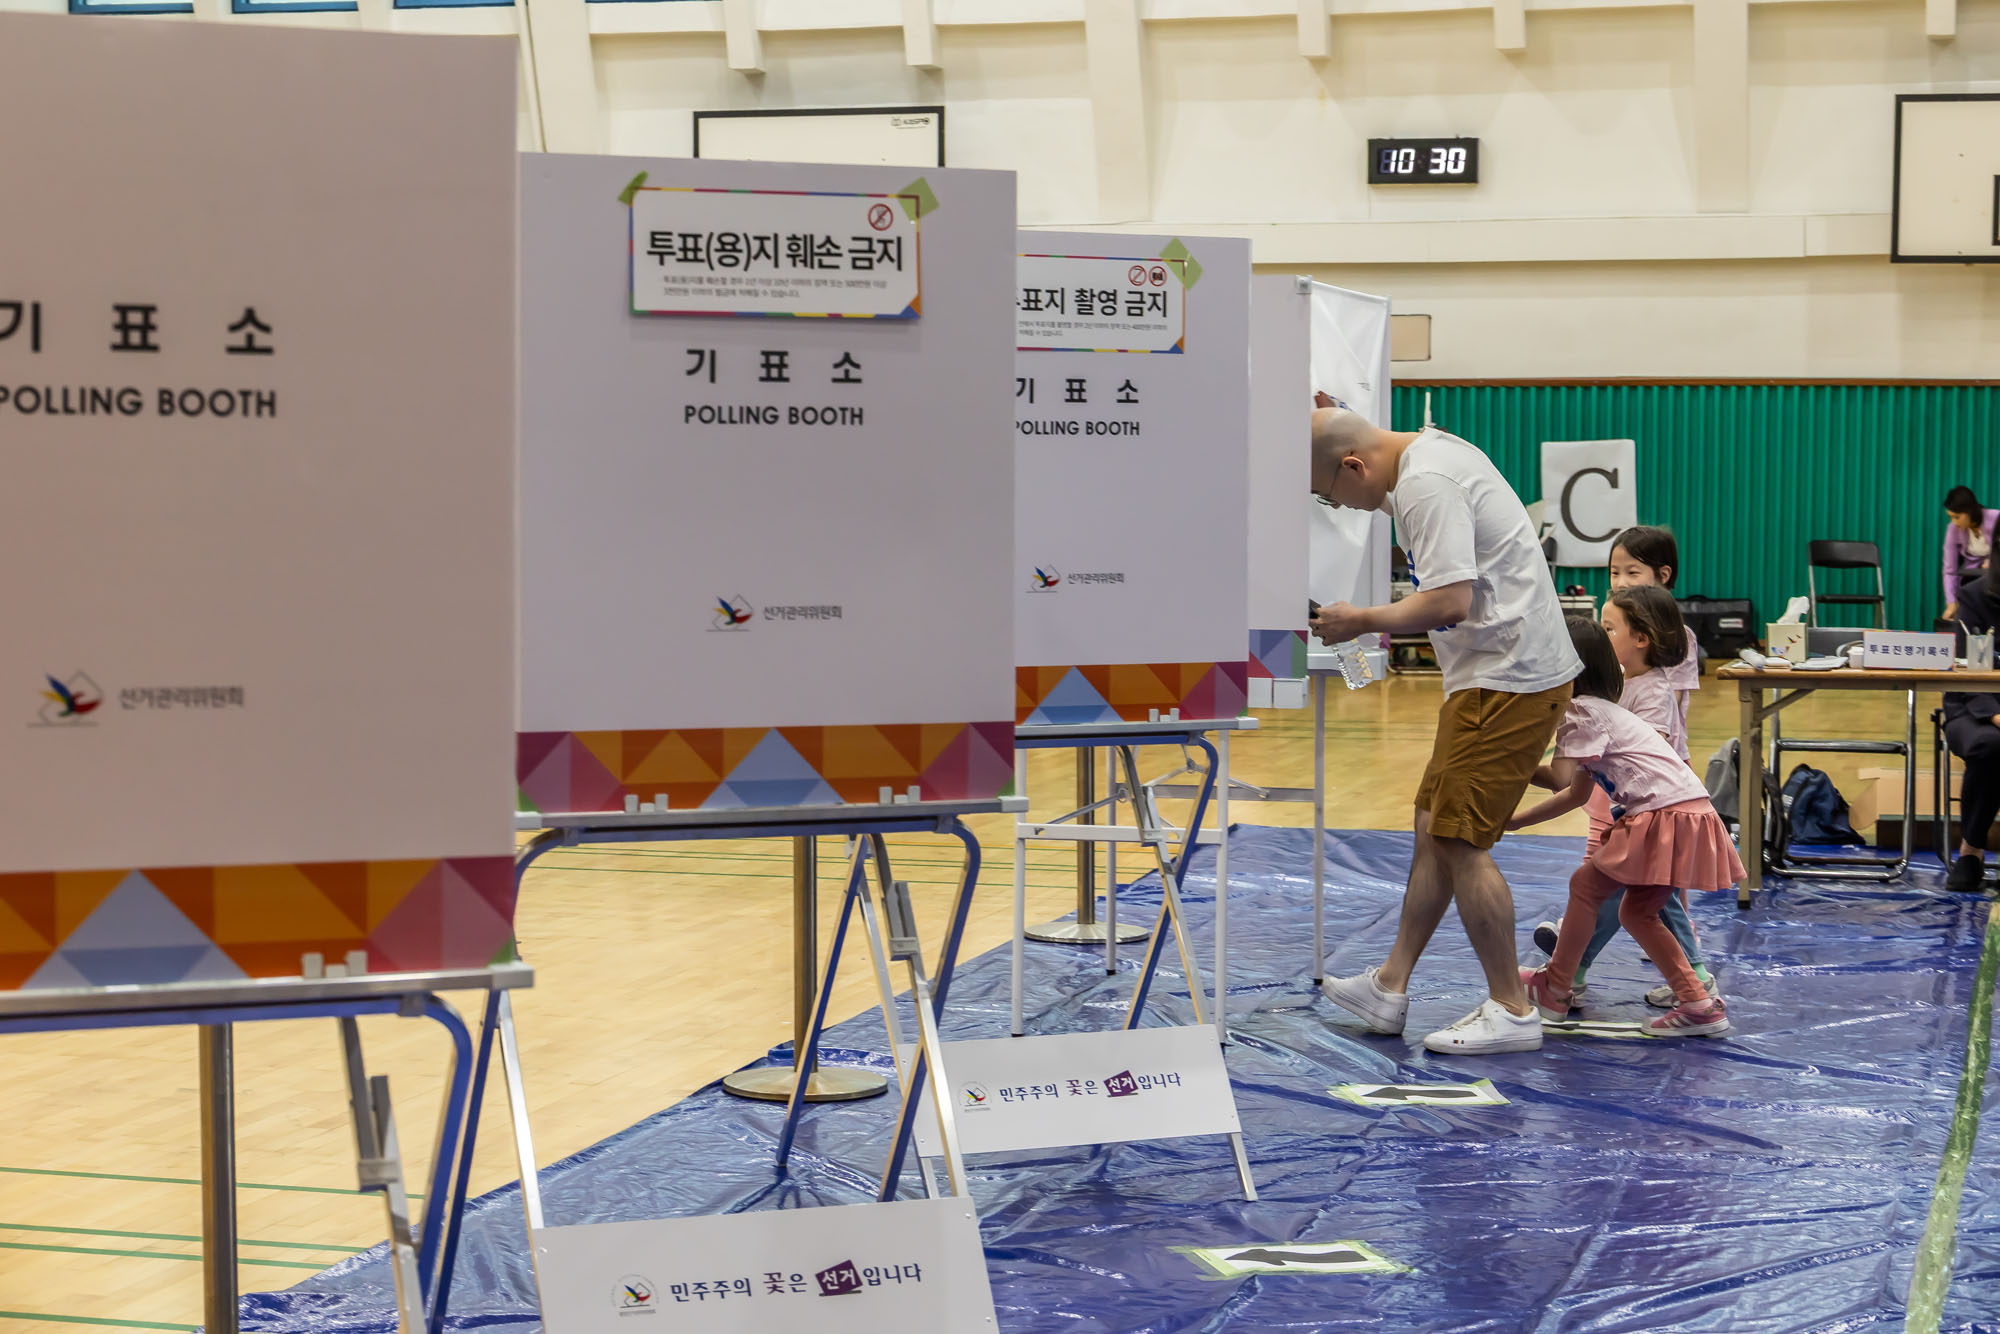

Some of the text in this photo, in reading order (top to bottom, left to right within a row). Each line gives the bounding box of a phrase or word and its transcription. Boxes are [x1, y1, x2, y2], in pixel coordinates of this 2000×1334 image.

[1389, 147, 1467, 174] 10 30
[647, 230, 903, 272] 투표(용)지 훼손 금지
[1016, 287, 1167, 318] 표지 촬영 금지
[0, 300, 275, 356] 기 표 소
[686, 348, 863, 384] 기 표 소
[157, 387, 277, 418] BOOTH
[1016, 377, 1140, 404] 기 표 소
[684, 404, 864, 426] POLLING BOOTH
[1085, 420, 1140, 436] BOOTH
[1560, 467, 1621, 543] C
[763, 605, 843, 621] 선거관리위원회
[119, 685, 244, 710] 선거관리위원회
[999, 1083, 1059, 1103] 민주주의
[1066, 1079, 1099, 1096] 꽃은
[669, 1277, 752, 1303] 민주주의
[763, 1271, 808, 1295] 꽃은
